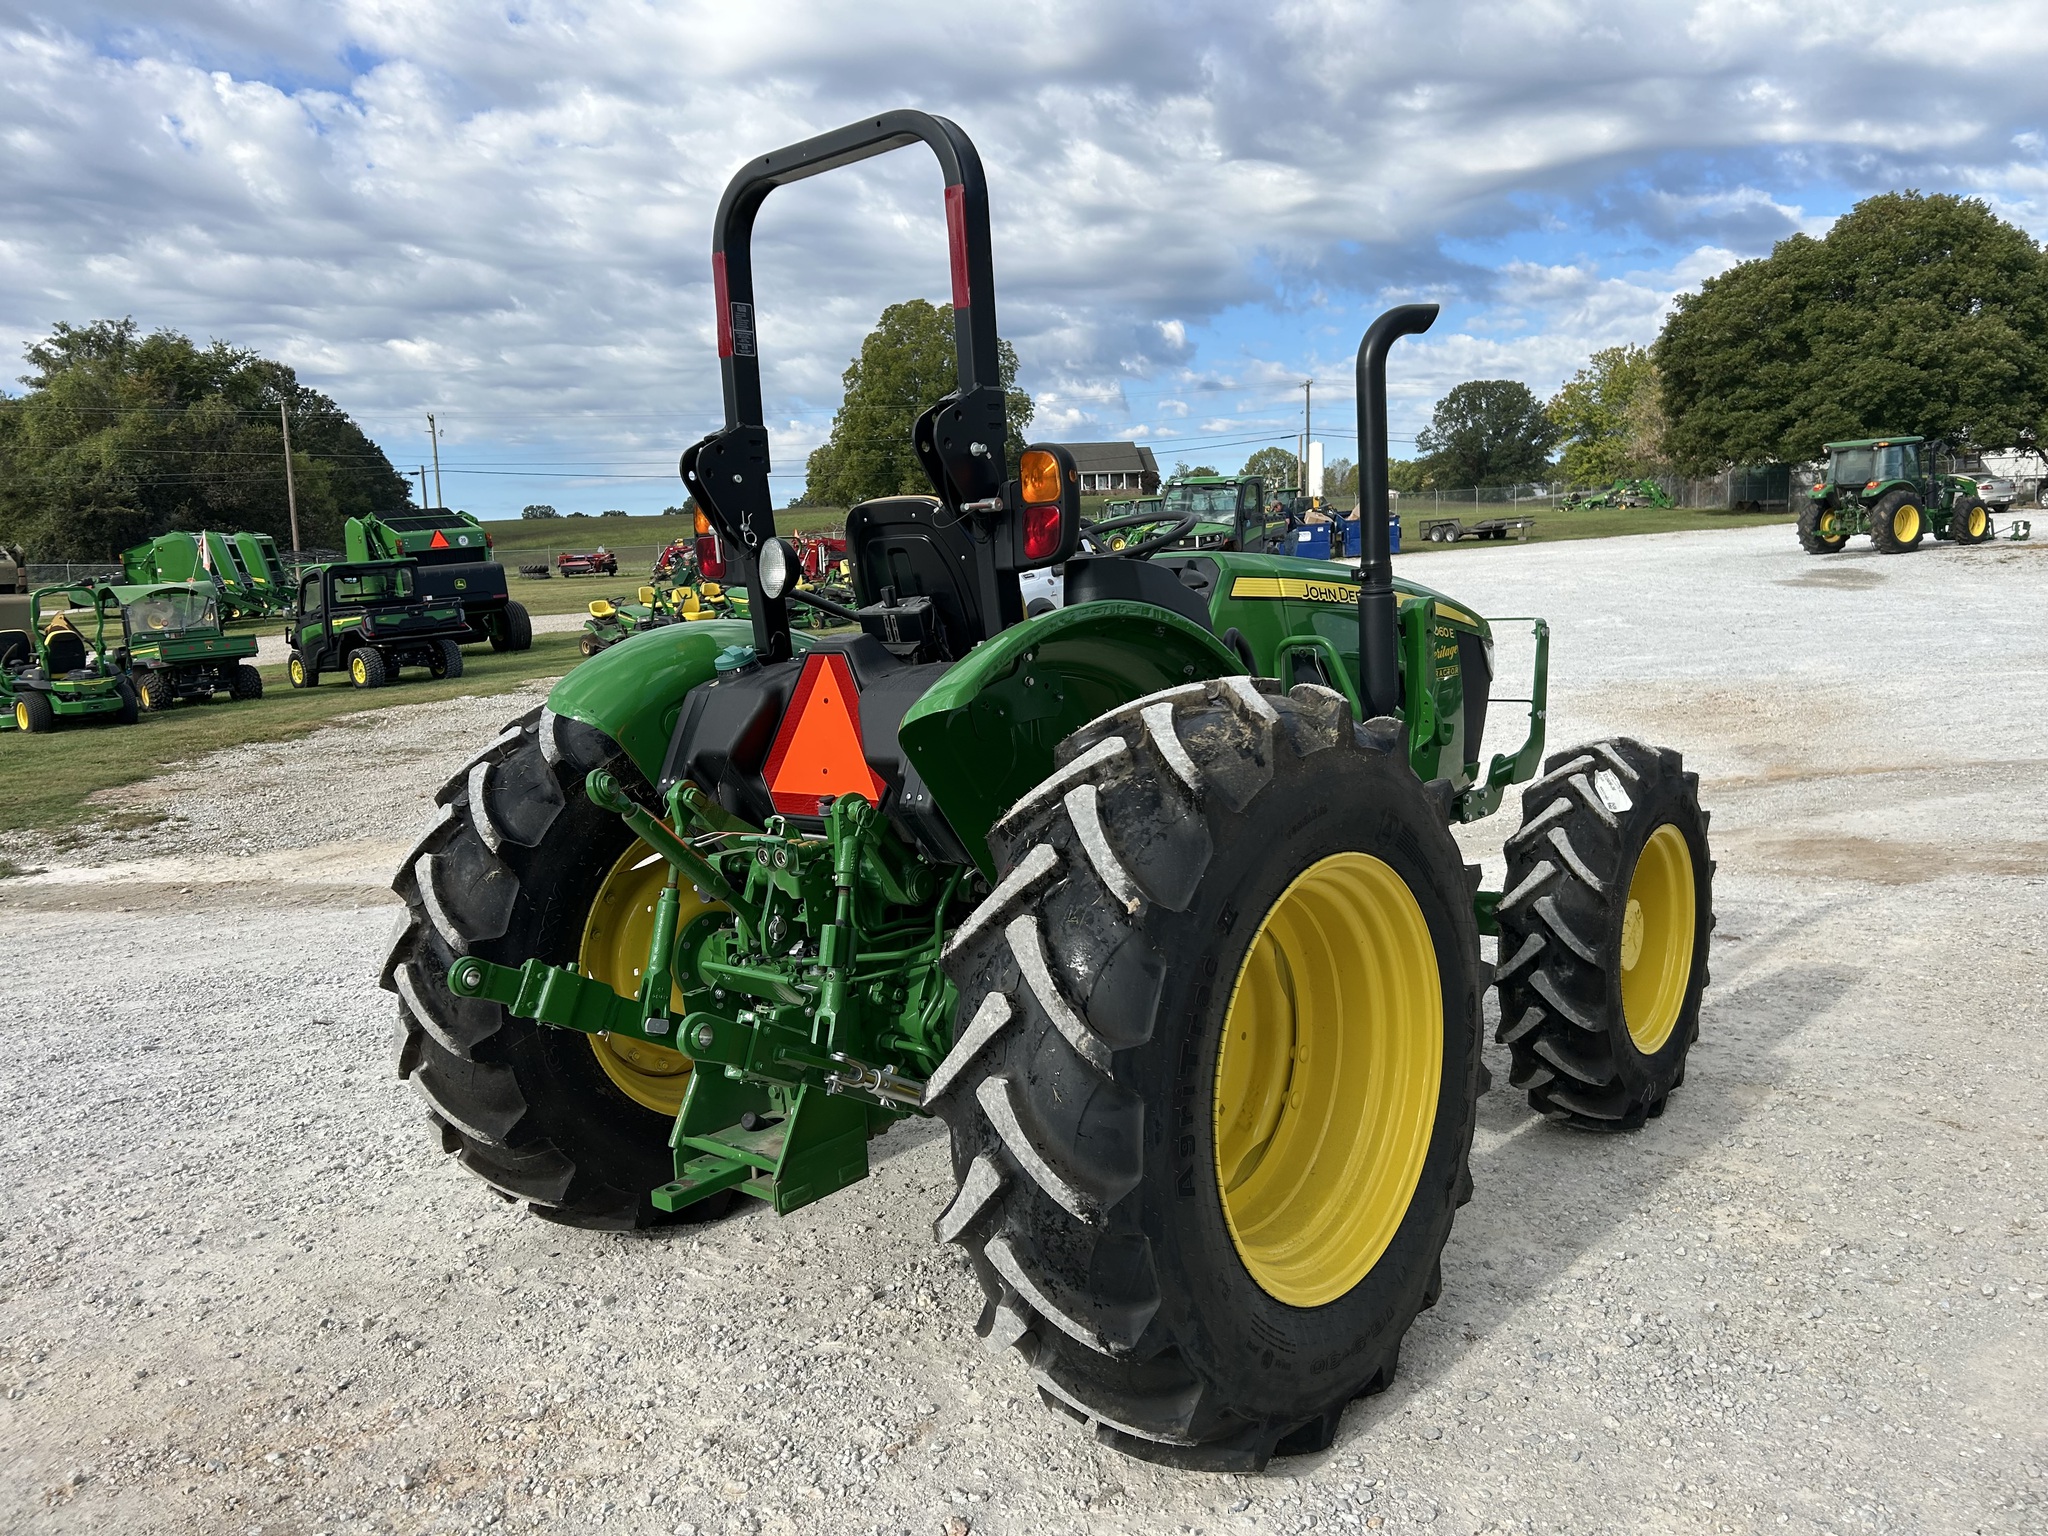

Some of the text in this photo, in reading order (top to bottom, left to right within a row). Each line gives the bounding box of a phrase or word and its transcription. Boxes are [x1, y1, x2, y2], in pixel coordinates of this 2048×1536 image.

[1302, 583, 1361, 604] JOHN DEE
[1434, 625, 1455, 639] 060E
[1434, 644, 1459, 661] eritage
[1435, 666, 1459, 677] RACTOR
[1173, 955, 1219, 1198] AgriTrac
